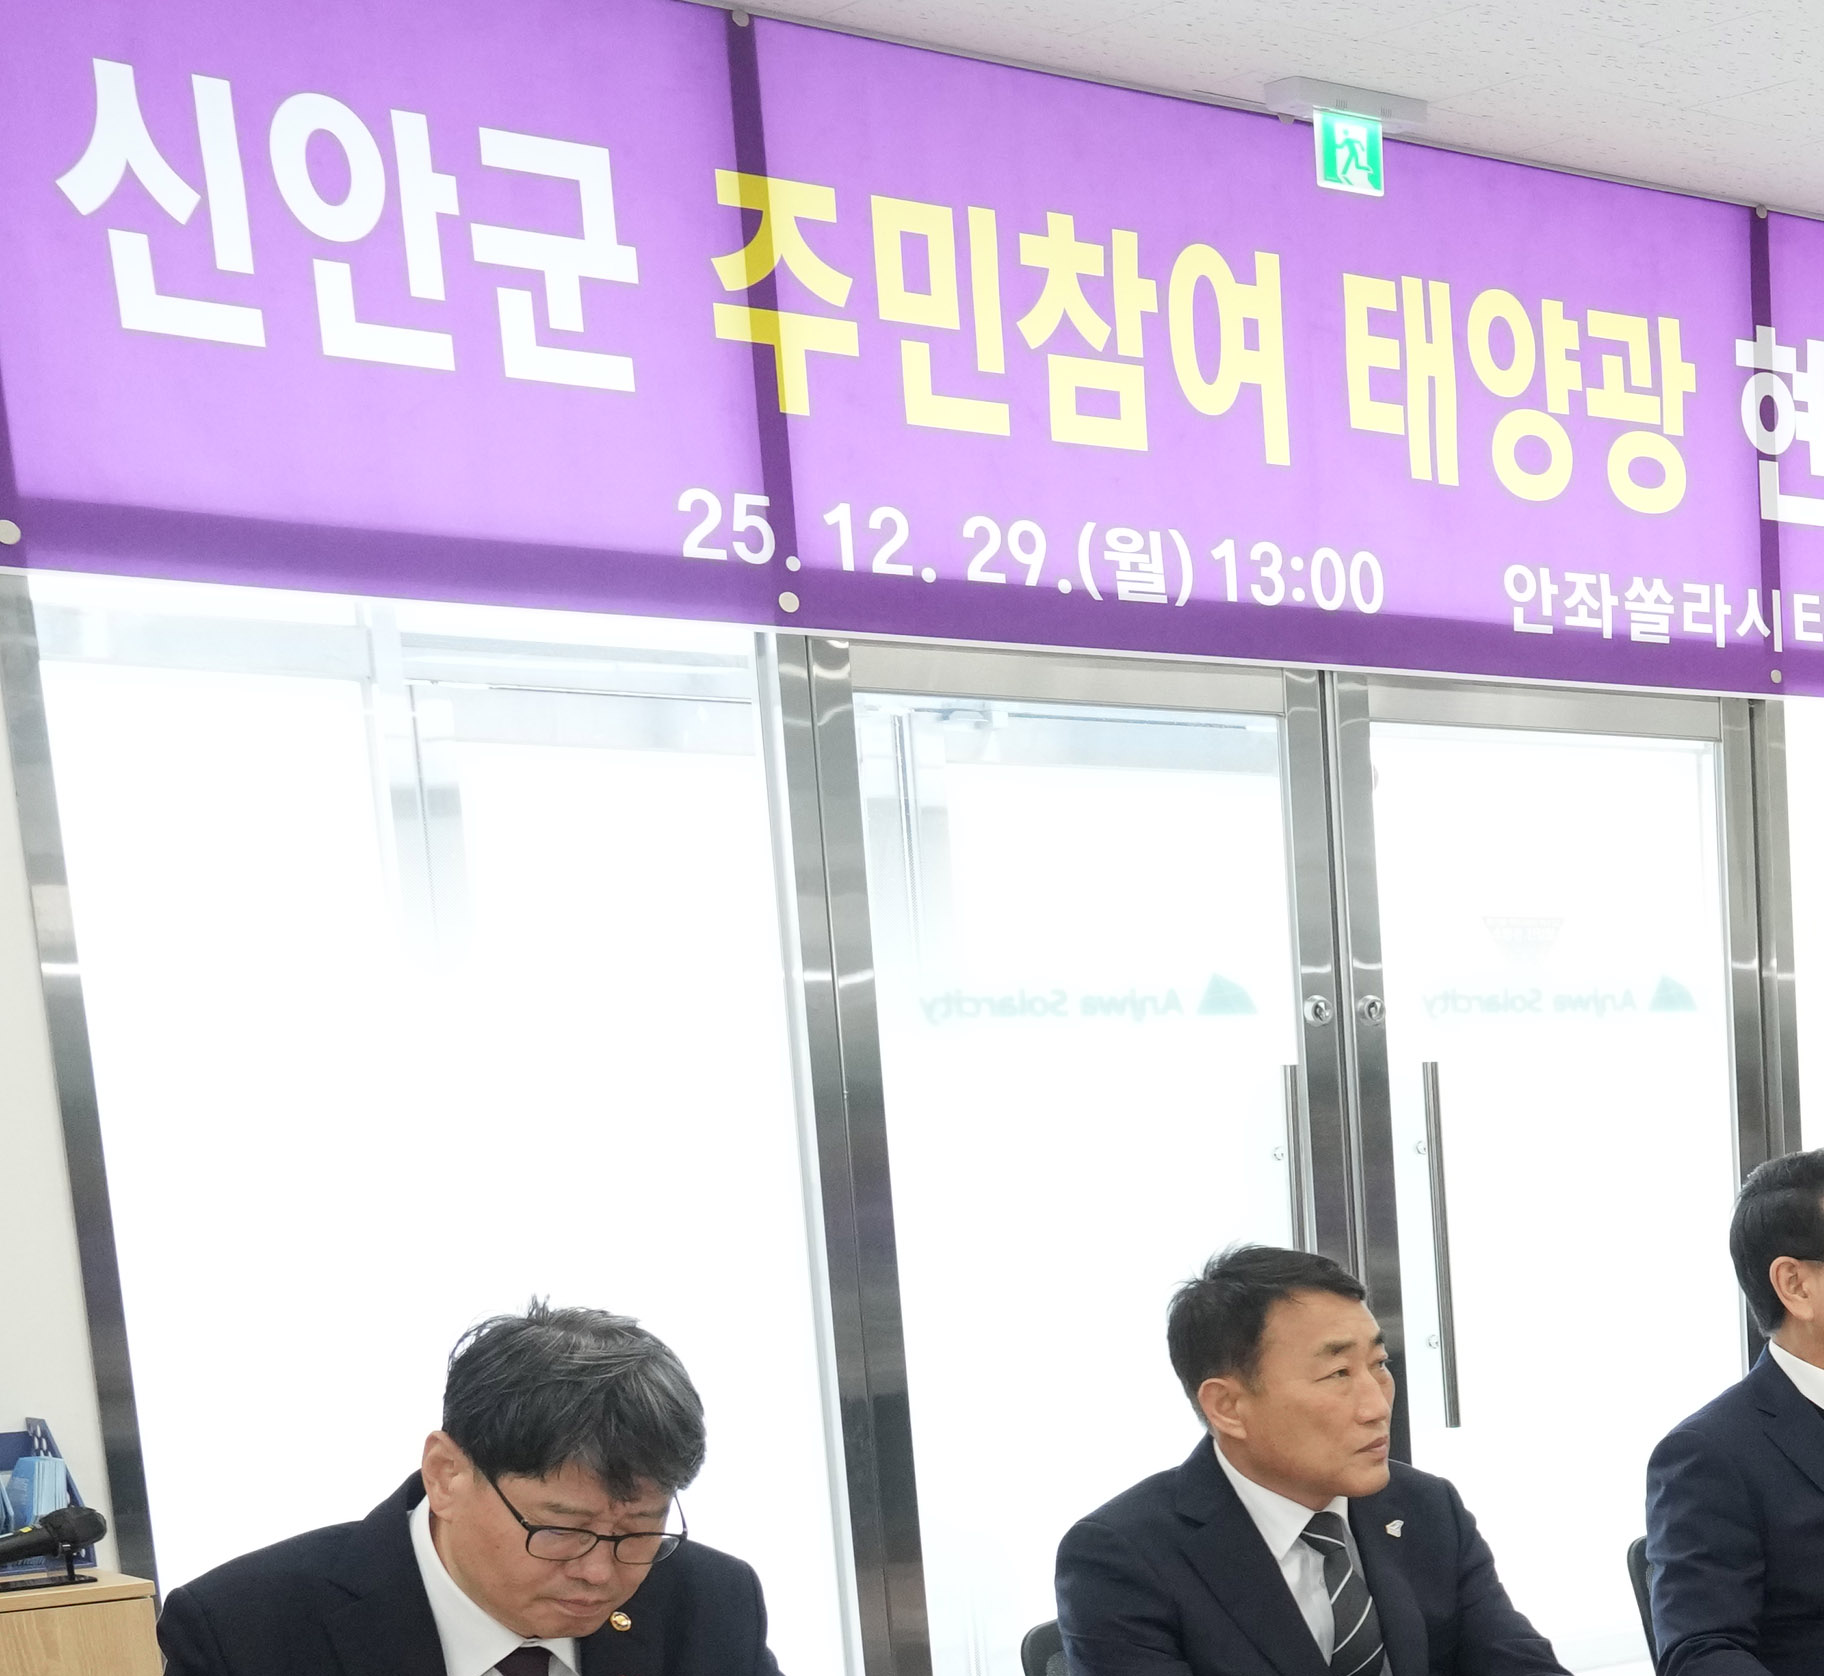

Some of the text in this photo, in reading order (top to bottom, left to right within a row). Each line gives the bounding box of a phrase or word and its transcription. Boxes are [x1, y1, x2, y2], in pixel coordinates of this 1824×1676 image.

[56, 58, 638, 393] 신안군
[711, 168, 1291, 468] 주민참여
[1342, 273, 1696, 514] 태양광
[677, 488, 801, 572] 25.
[823, 505, 937, 583] 12.
[1211, 537, 1384, 614] 13:00
